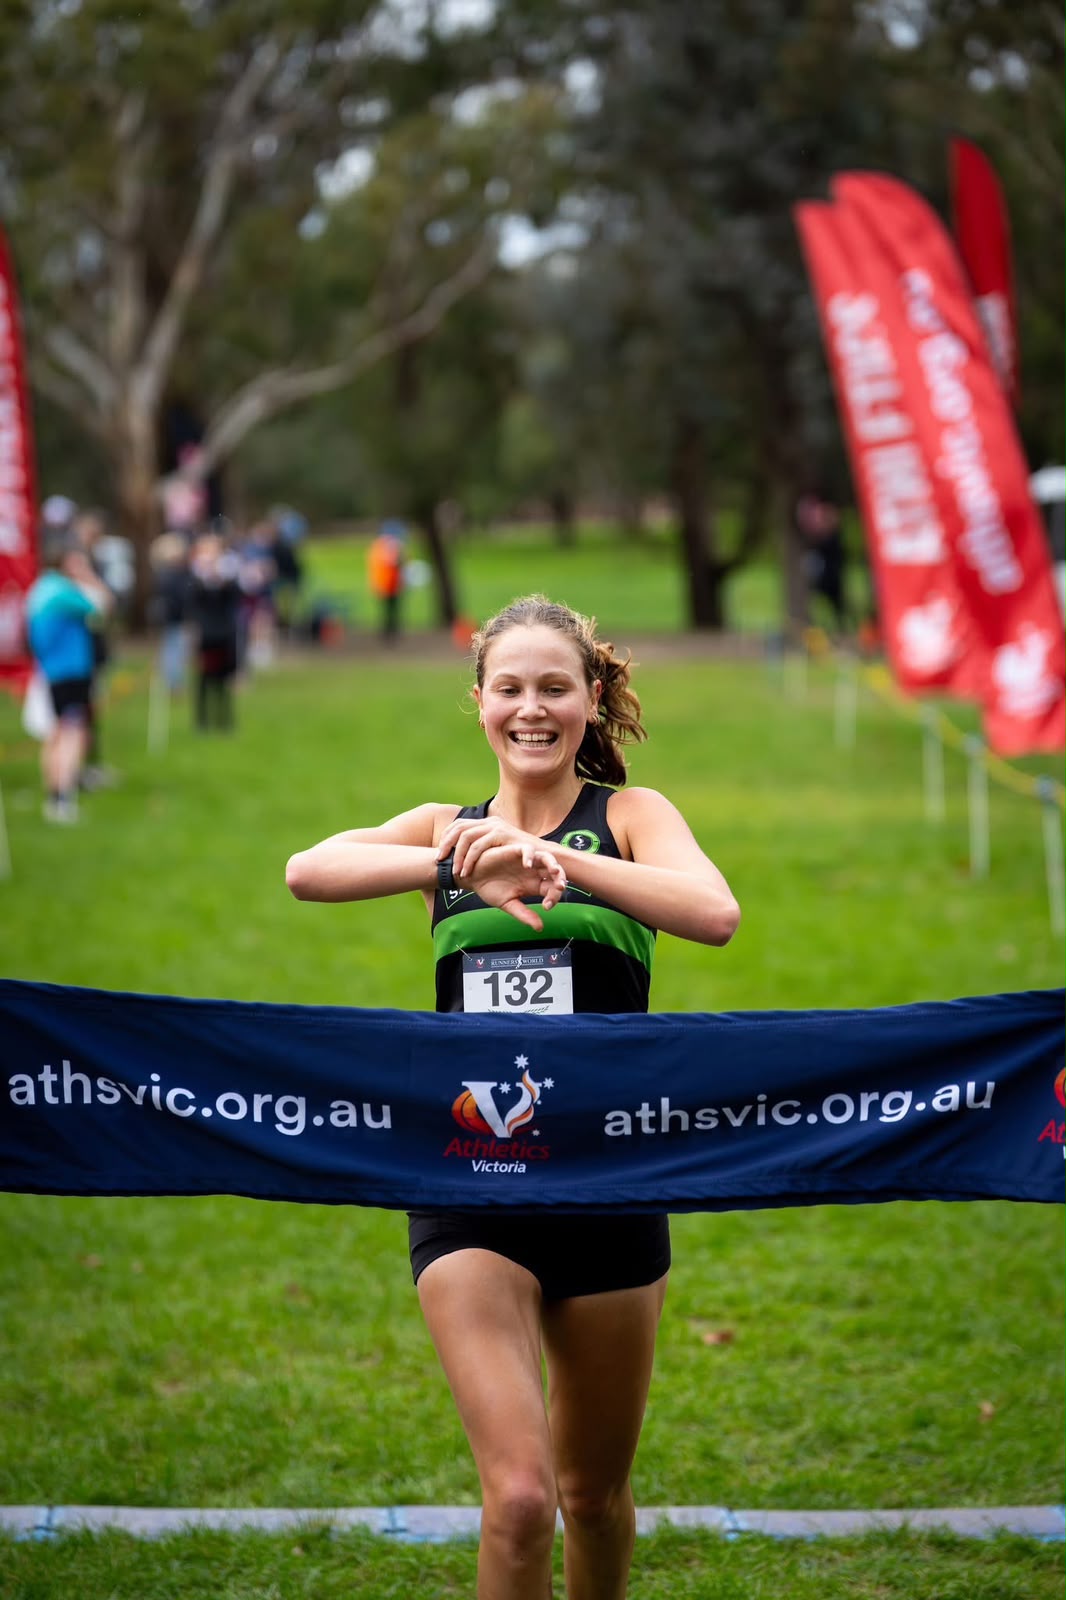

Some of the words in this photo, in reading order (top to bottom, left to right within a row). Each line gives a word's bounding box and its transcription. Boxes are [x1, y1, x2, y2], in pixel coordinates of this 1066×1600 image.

[522, 958, 544, 966] WORLD
[483, 970, 553, 1006] 132
[8, 1060, 392, 1136] athsvic.org.au
[603, 1081, 995, 1136] athsvic.org.au
[443, 1137, 551, 1160] Athletics
[471, 1159, 527, 1173] Victoria
